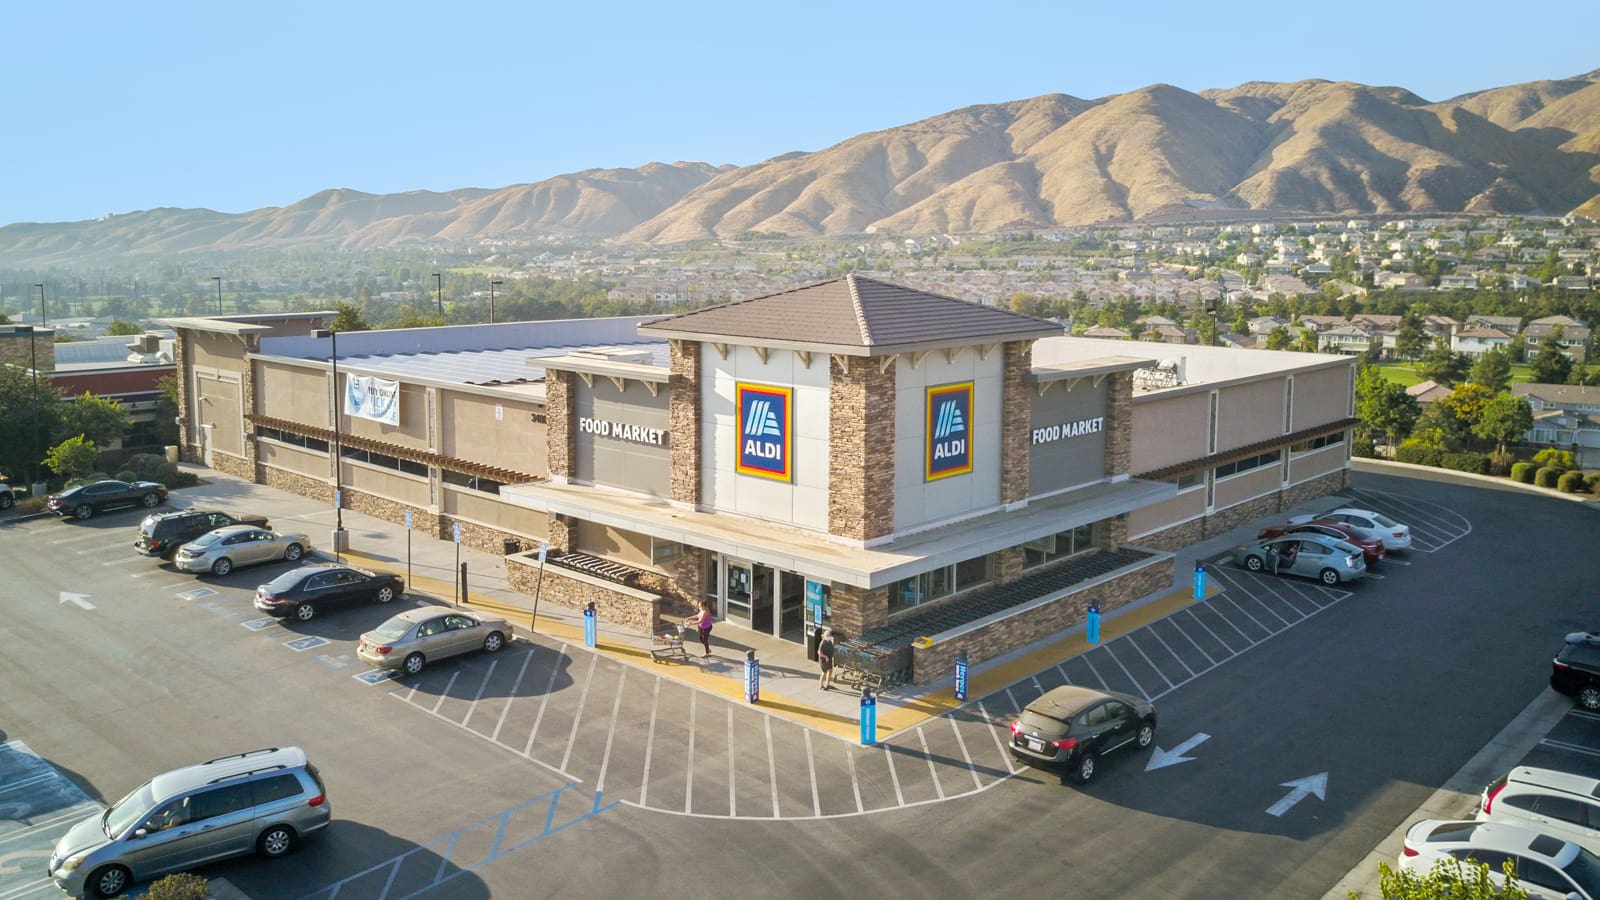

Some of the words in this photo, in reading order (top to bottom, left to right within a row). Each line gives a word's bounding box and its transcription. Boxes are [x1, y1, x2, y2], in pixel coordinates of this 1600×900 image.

[579, 417, 609, 436] FOOD
[612, 422, 664, 445] MARKET
[1032, 425, 1060, 445] FOOD
[1061, 417, 1104, 439] MARKET
[744, 439, 781, 460] ALDI
[934, 439, 965, 460] ALDI
